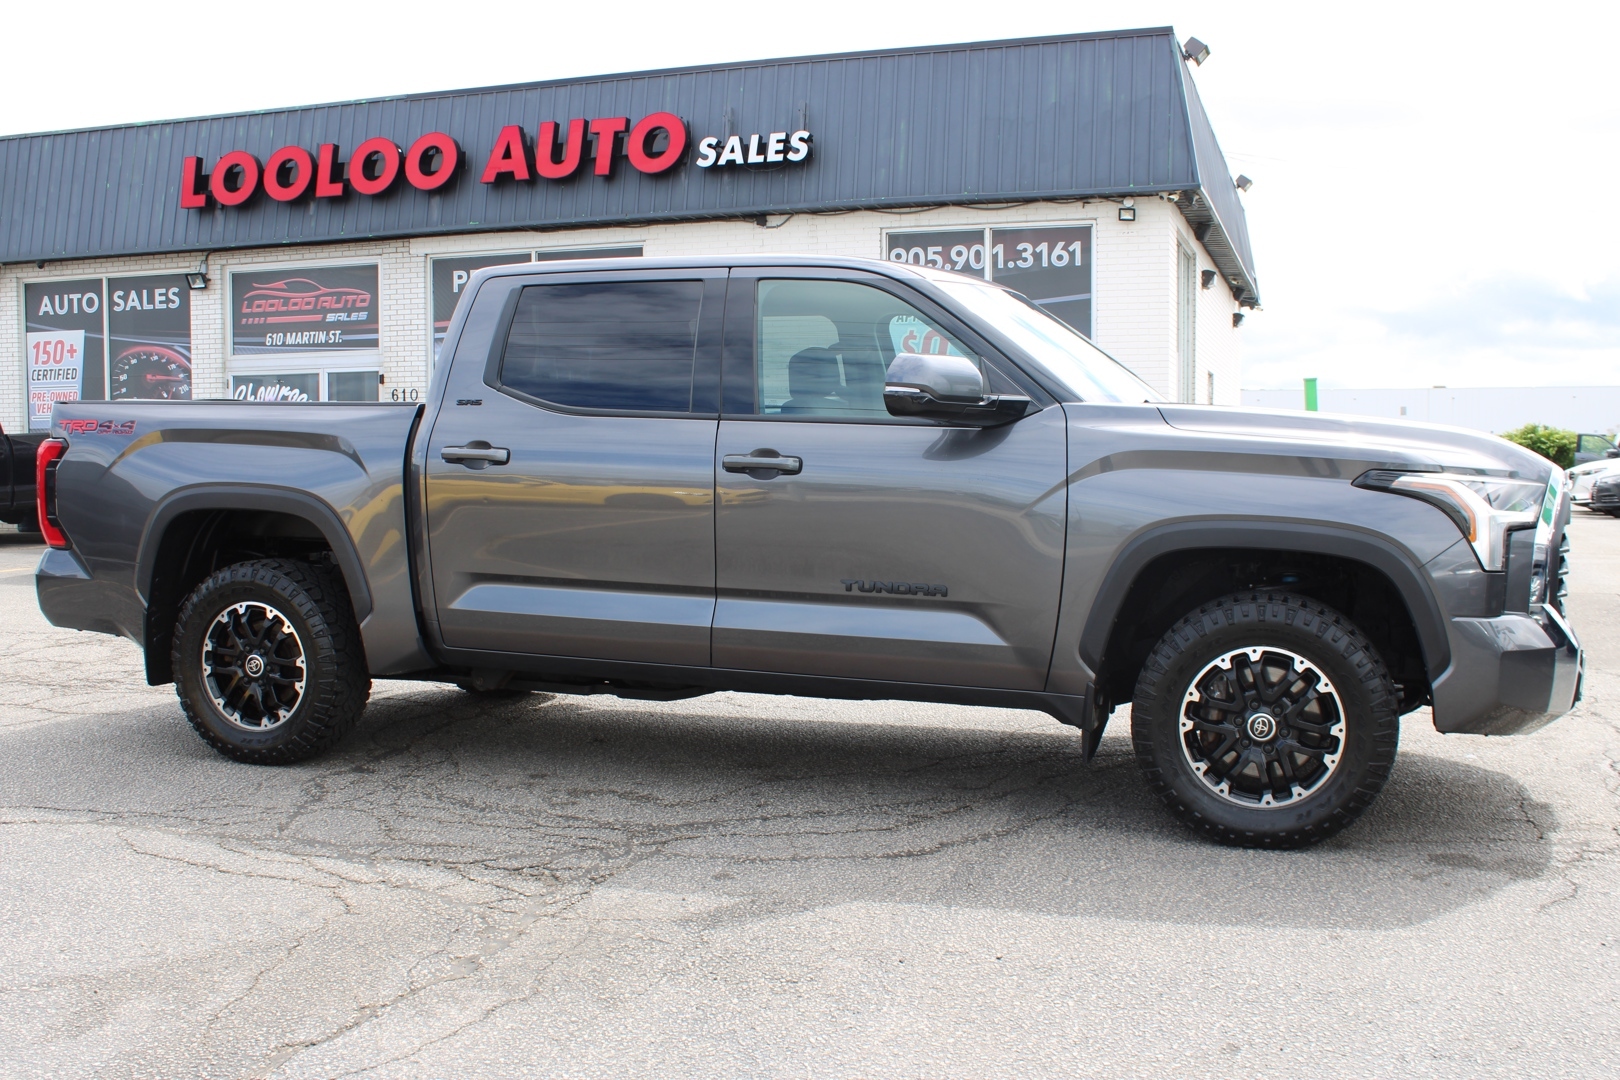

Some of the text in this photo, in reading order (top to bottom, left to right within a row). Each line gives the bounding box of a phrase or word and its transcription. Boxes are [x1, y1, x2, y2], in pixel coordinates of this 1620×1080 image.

[181, 112, 810, 209] LOOLOO AUTO SALES
[39, 287, 180, 316] AUTO SALES
[241, 294, 371, 313] LOOLOO AUTO
[325, 311, 368, 322] SALES
[265, 330, 342, 346] 610 MARTIN ST.
[32, 339, 78, 365] 150+
[31, 367, 78, 381] CERTIFIED
[31, 391, 78, 403] PRE-OWNED
[391, 388, 419, 402] 610
[58, 419, 98, 435] TRD
[840, 579, 948, 597] TUNDRA
